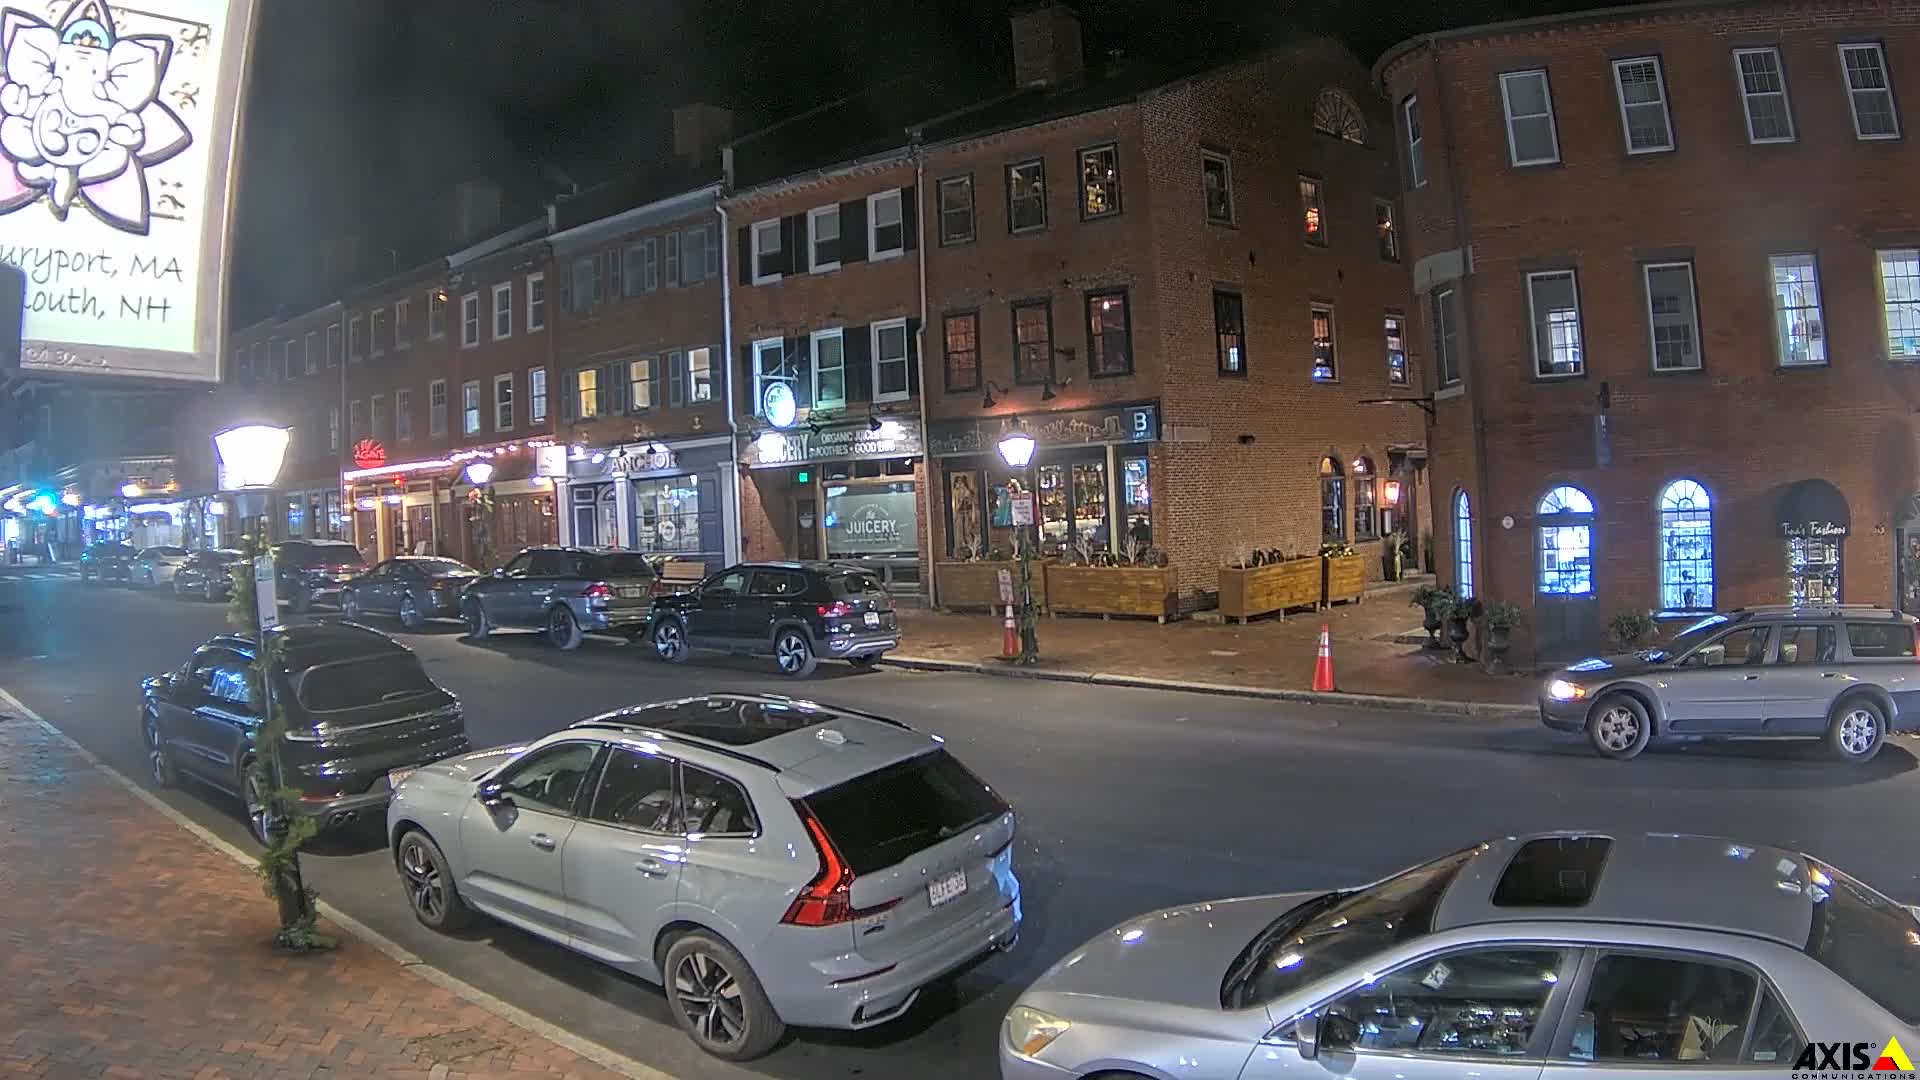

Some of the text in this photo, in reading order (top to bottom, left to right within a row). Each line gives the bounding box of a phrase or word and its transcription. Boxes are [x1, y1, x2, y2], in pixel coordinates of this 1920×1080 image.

[129, 254, 183, 282] MA
[23, 286, 172, 323] outh, NH
[1133, 411, 1147, 431] B
[758, 431, 808, 463] CERY
[821, 431, 852, 444] ORGANIC
[809, 444, 848, 459] SMOOTHIES
[855, 442, 876, 454] GOOD
[612, 452, 680, 473] ANCHOR
[846, 519, 897, 535] JUICERY
